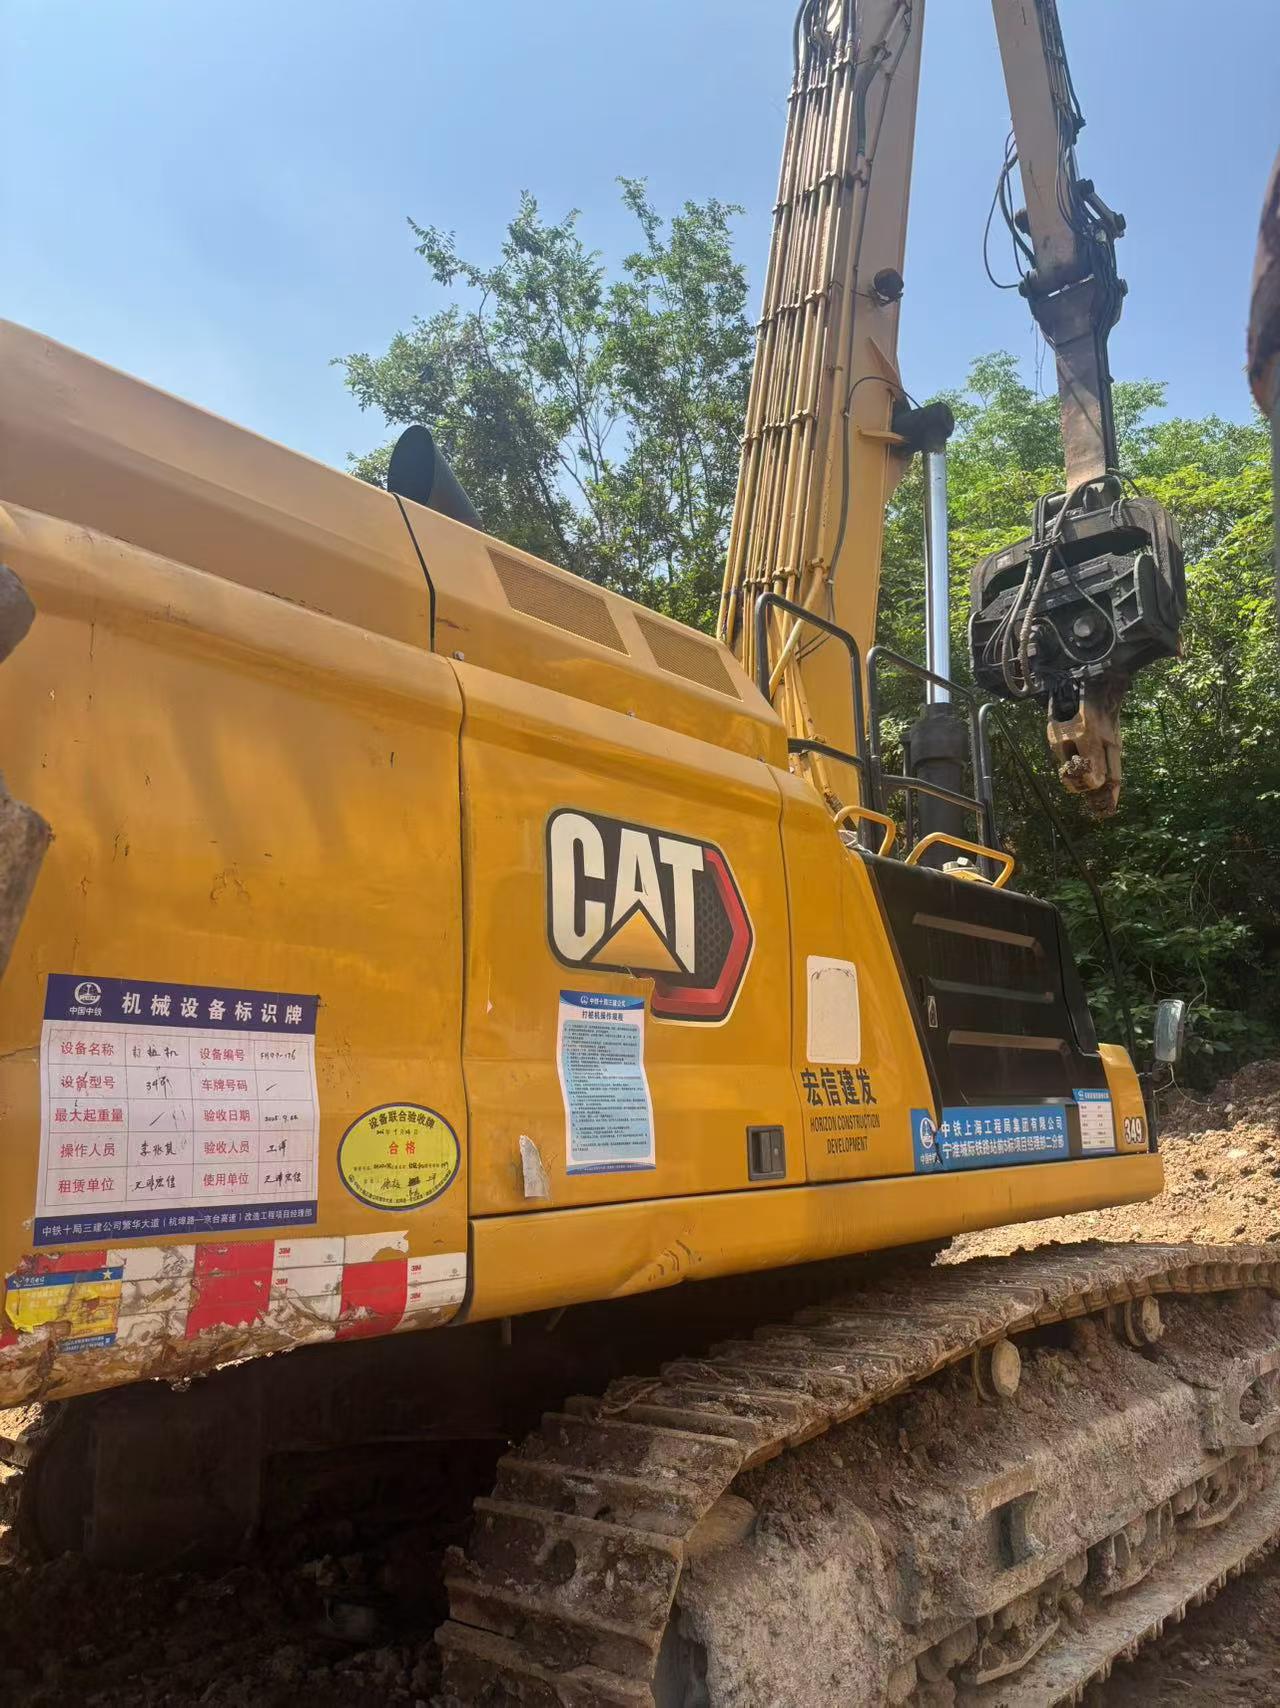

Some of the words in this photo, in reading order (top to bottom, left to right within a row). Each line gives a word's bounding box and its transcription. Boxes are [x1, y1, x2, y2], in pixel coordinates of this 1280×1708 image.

[550, 813, 704, 974] CAT
[69, 1006, 102, 1016] 中国中铁
[121, 991, 302, 1025] 机械设备标识牌
[60, 1041, 114, 1056] 设备名称
[200, 1048, 245, 1061] 设备编号
[60, 1074, 115, 1090] 设备型号
[202, 1079, 248, 1091] 车牌号码
[800, 1067, 878, 1106] 宏信建发
[55, 1108, 123, 1122] 最大起重量
[204, 1109, 250, 1122] 验收日期
[810, 1116, 837, 1132] HORIZON
[838, 1113, 880, 1130] CONSTRUCTION
[941, 1116, 1063, 1138] 中铁上海工程局集团有限公司
[1124, 1117, 1142, 1144] 349
[60, 1143, 115, 1158] 操作人员
[204, 1140, 249, 1154] 验收人员
[388, 1139, 416, 1155] 合格
[826, 1136, 868, 1154] DEVELOPMENT
[58, 1178, 114, 1193] 租赁单位
[203, 1173, 249, 1187] 使用单位
[278, 1247, 291, 1255] 3M
